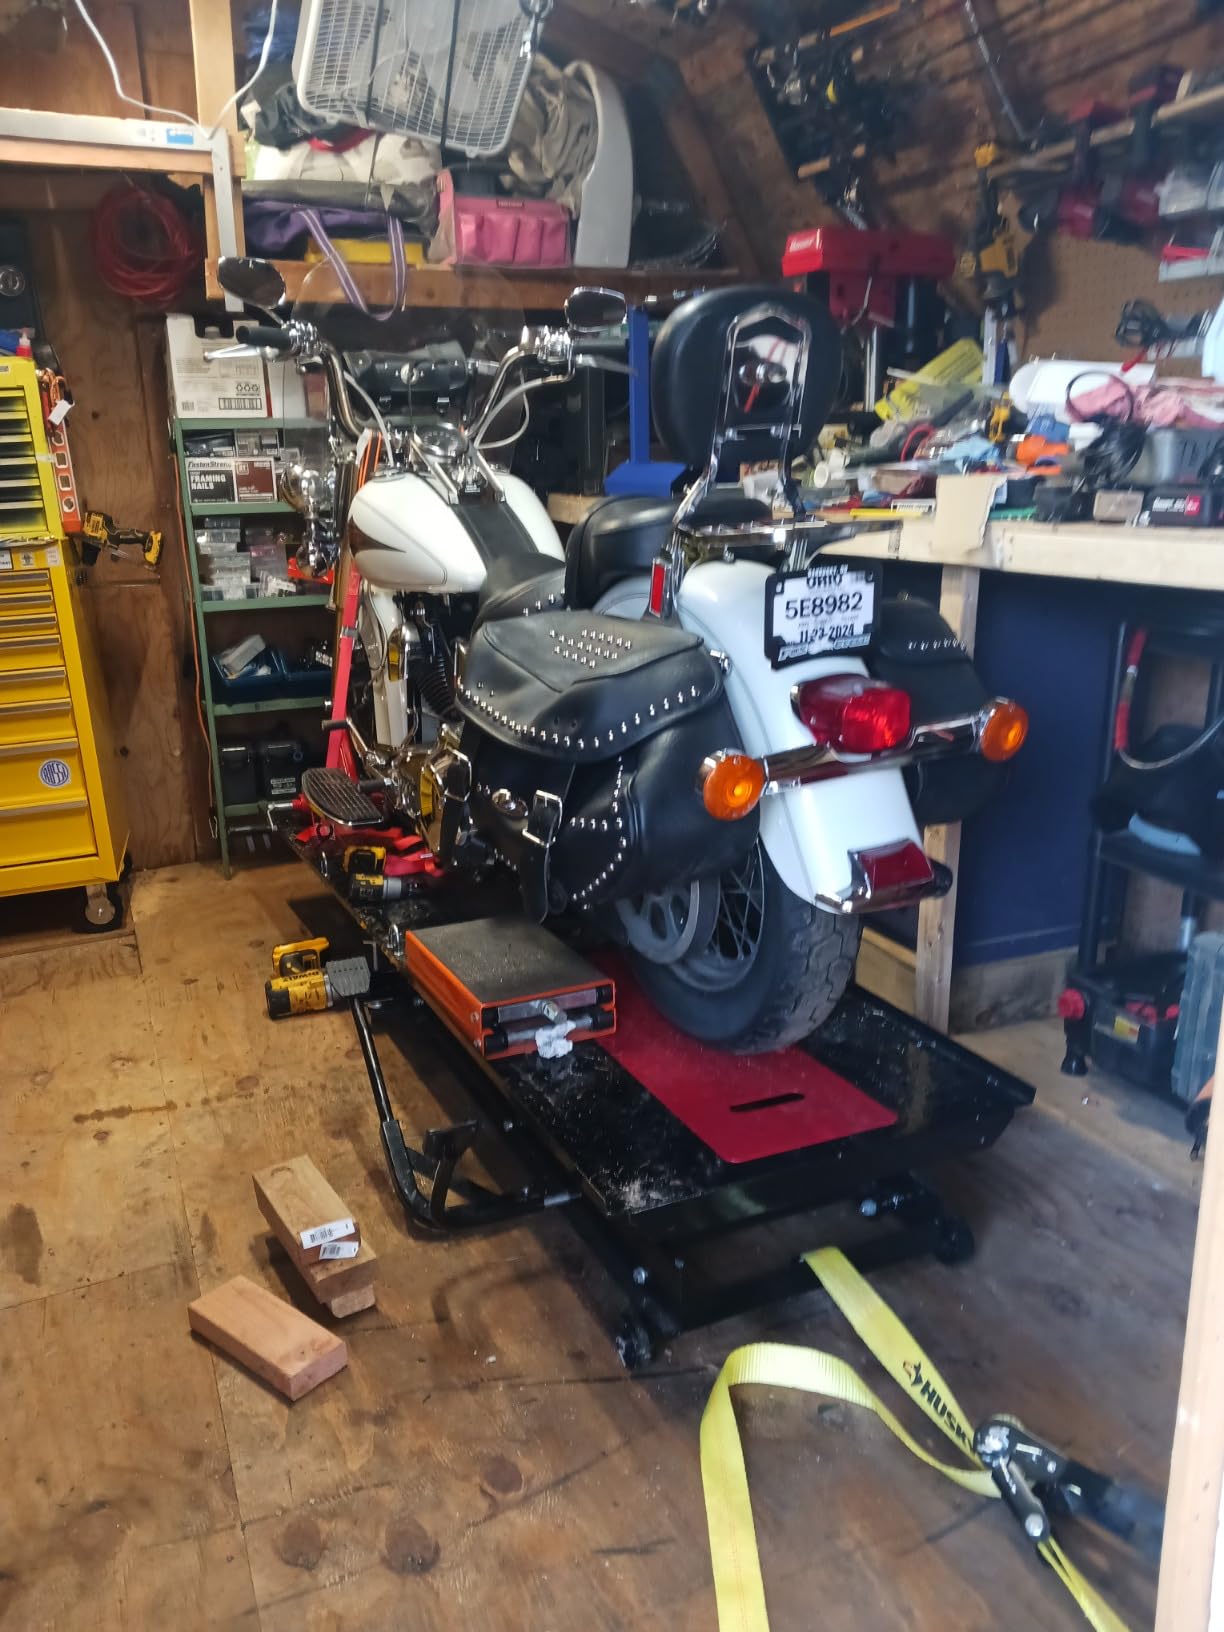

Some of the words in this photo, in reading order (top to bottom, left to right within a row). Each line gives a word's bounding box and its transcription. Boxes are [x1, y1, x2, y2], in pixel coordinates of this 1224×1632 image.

[190, 474, 227, 483] FRAMING
[191, 482, 215, 490] NAILS
[785, 591, 863, 620] 5E8982
